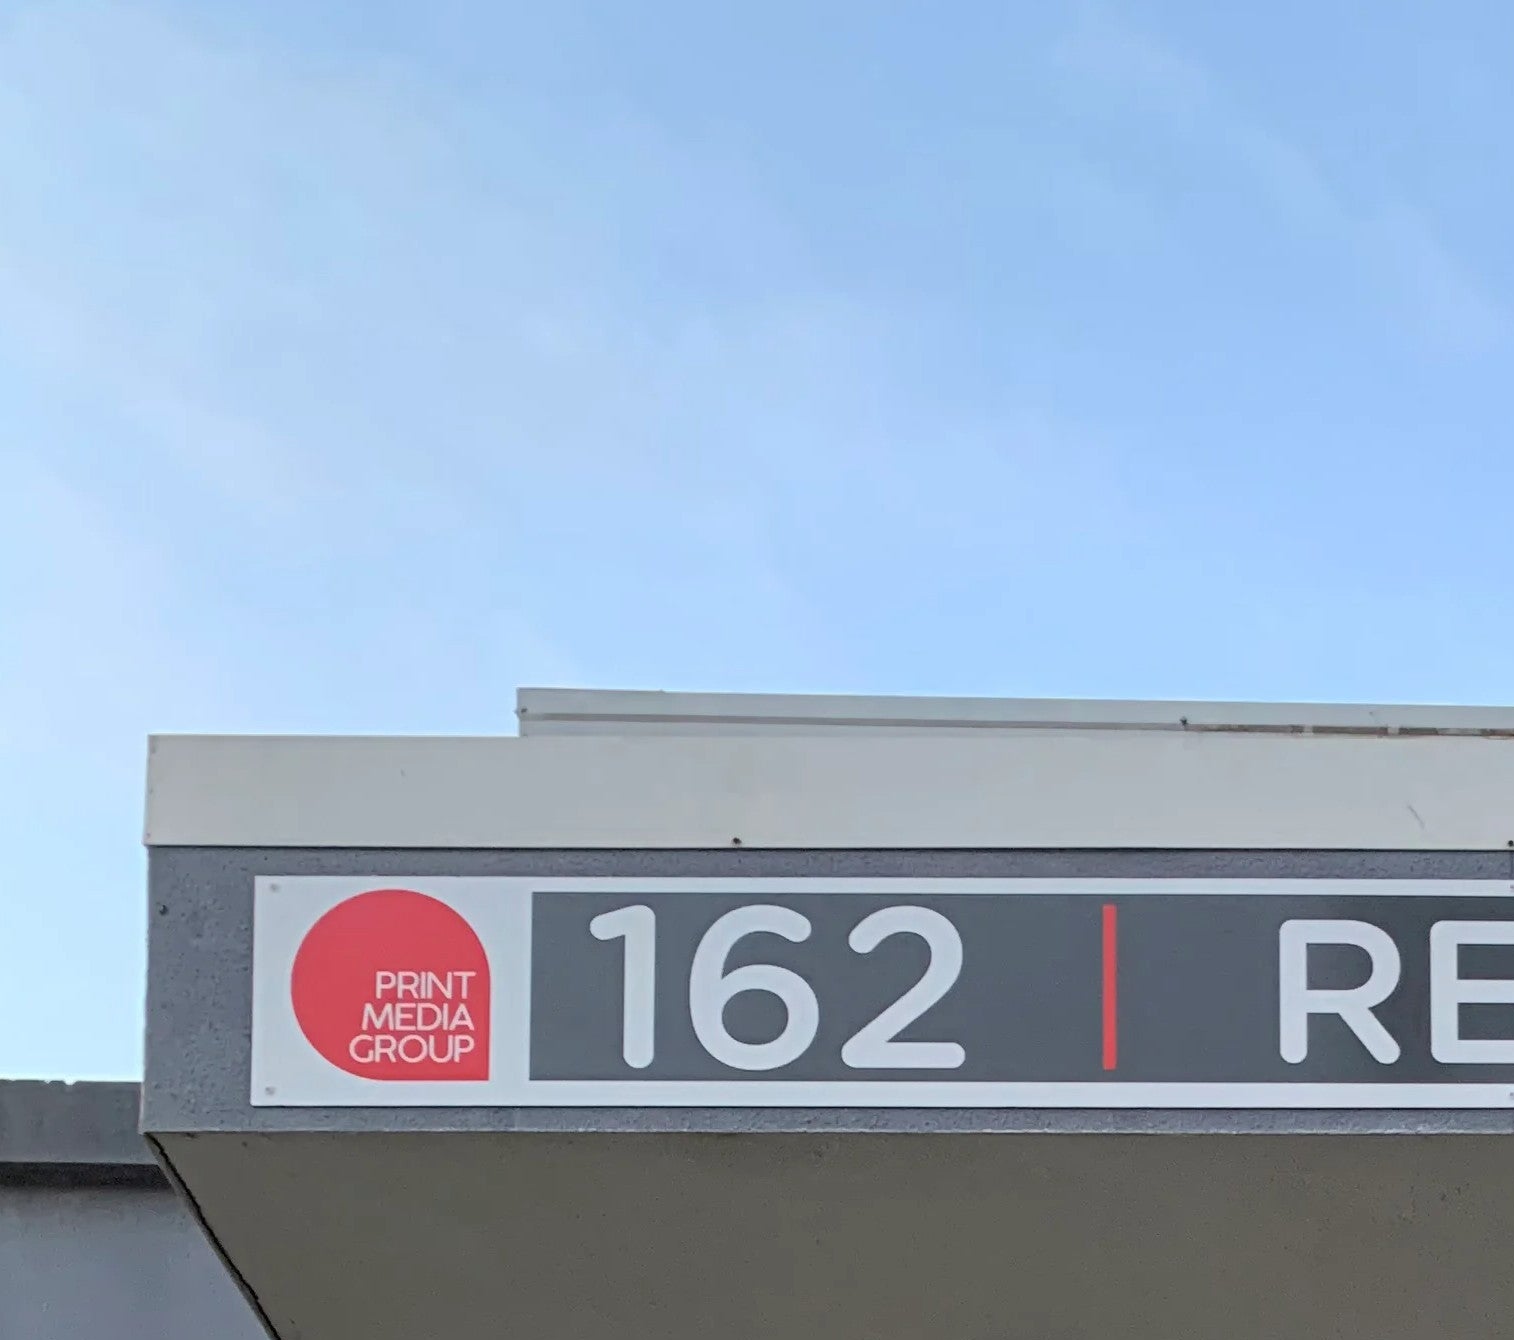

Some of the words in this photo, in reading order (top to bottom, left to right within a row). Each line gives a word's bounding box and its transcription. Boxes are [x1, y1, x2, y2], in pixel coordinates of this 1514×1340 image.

[375, 970, 477, 1000] PRINT
[590, 904, 966, 1071] 162
[361, 1002, 475, 1031] MEDIA
[348, 1034, 475, 1063] GROUP
